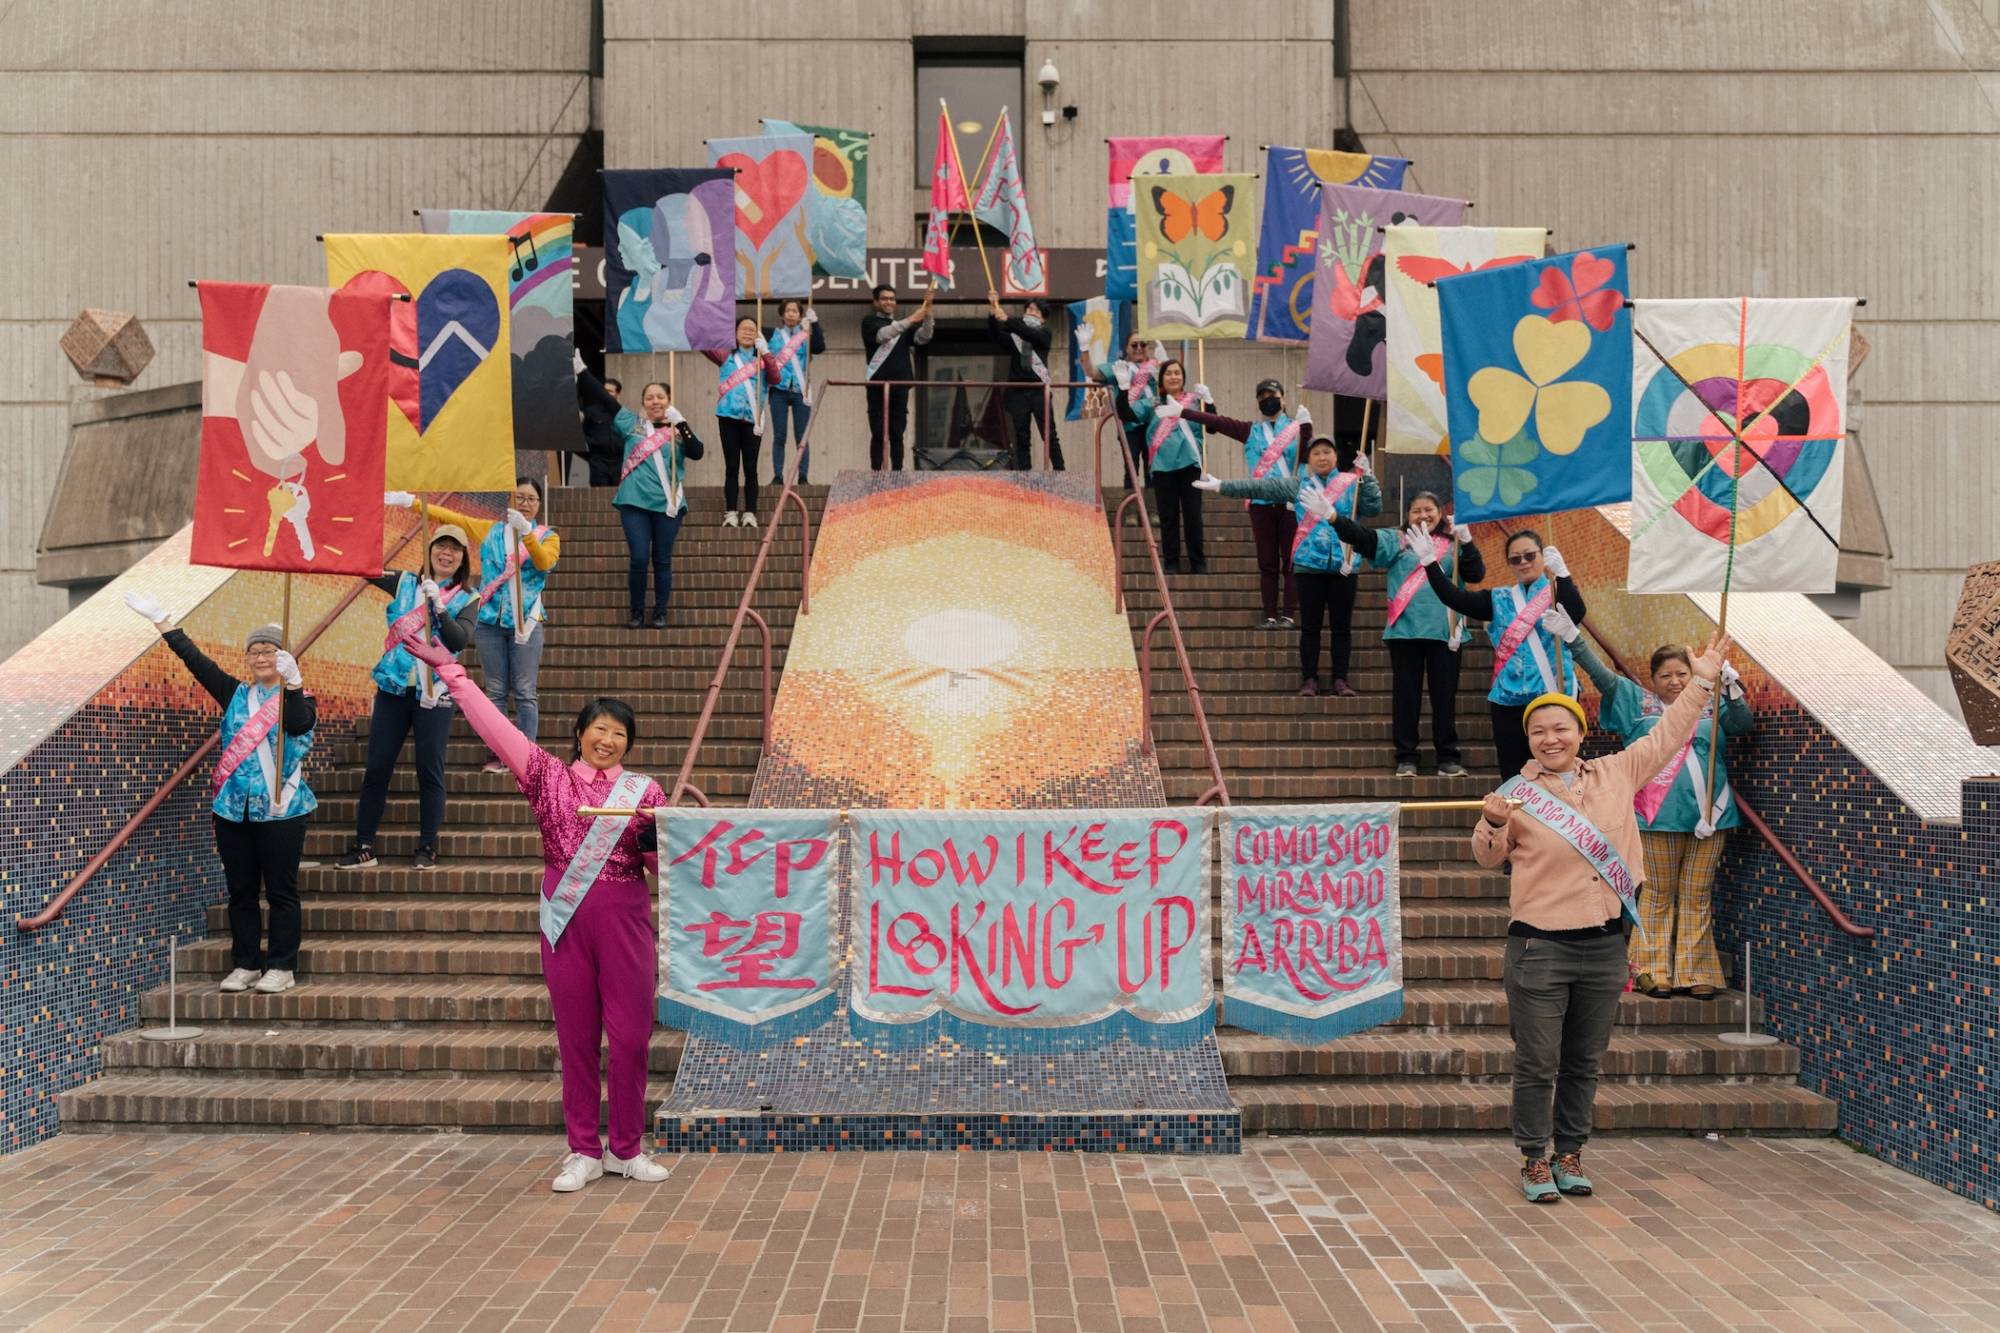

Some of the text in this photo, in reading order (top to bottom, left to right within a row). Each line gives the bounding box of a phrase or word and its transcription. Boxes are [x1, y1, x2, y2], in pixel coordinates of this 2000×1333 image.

[812, 258, 955, 289] NTE
[591, 813, 621, 865] LOOKIN
[865, 819, 1189, 896] HOW I KEEP
[1235, 822, 1390, 867] COMO SIGO
[1560, 815, 1609, 861] MIRANDO
[670, 820, 829, 992] 仰望
[1236, 867, 1385, 915] MIRANDO
[864, 895, 1197, 1017] LOOKING UP
[1230, 916, 1389, 1002] ARRIBA
